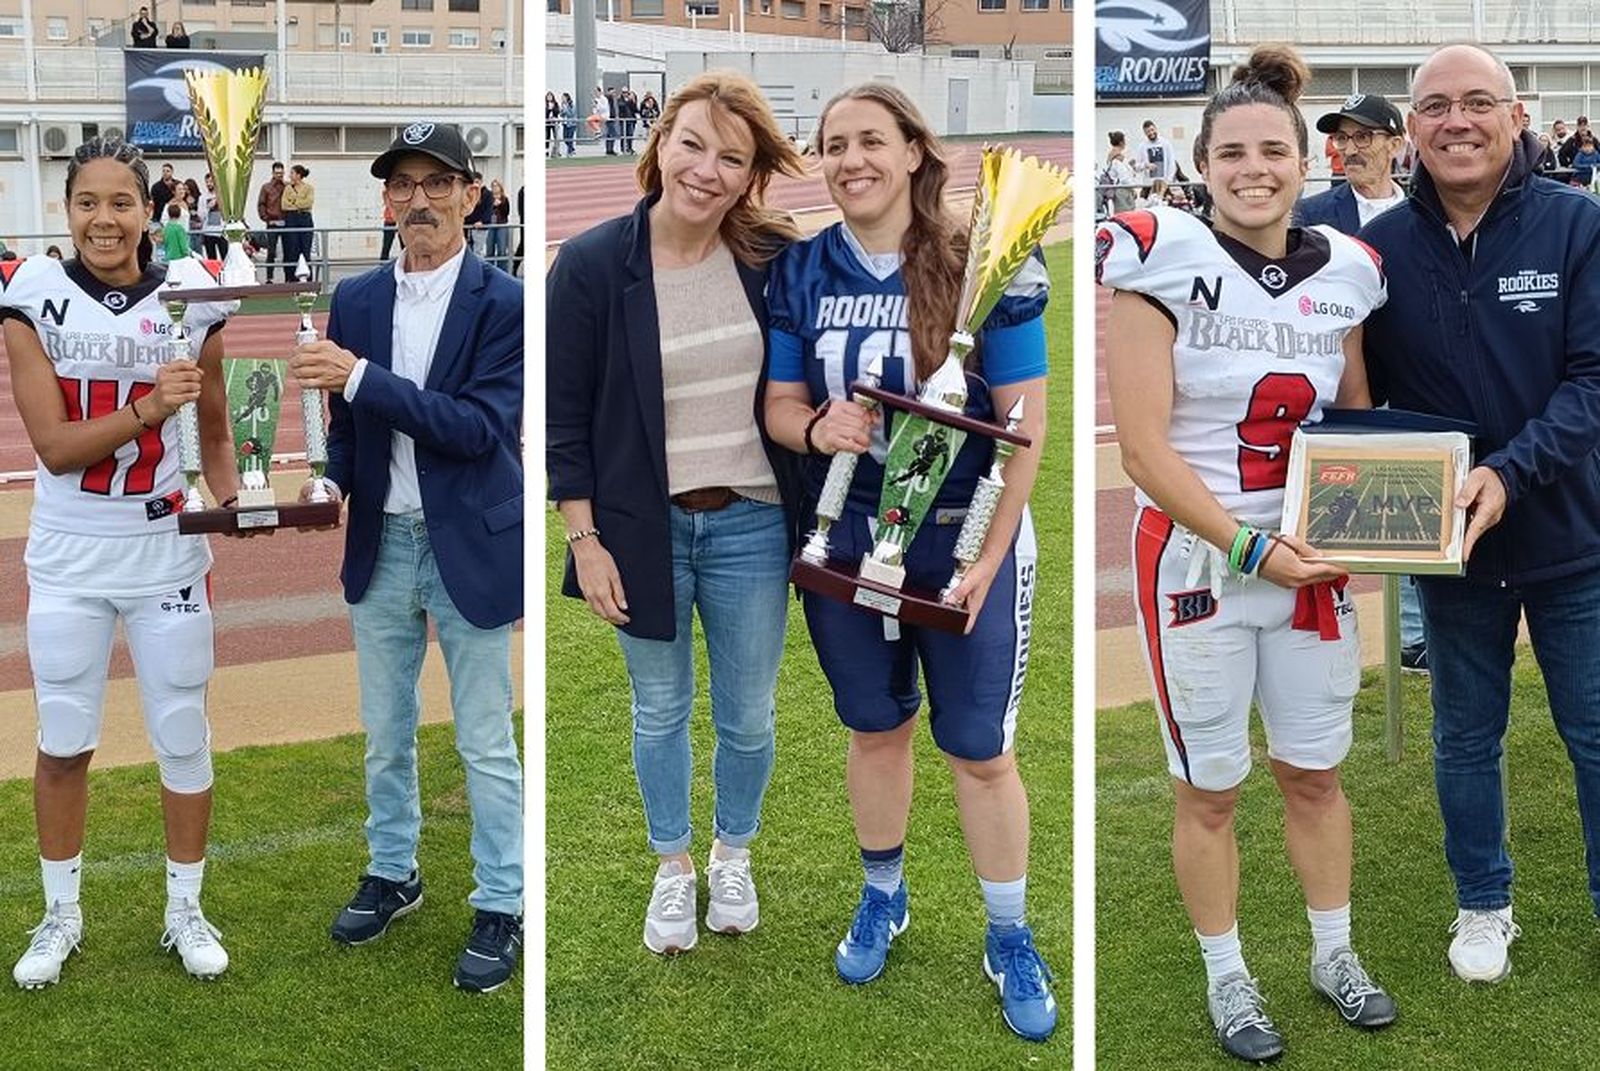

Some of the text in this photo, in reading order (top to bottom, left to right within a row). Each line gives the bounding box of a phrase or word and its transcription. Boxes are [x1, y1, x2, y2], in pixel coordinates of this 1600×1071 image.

[1119, 57, 1209, 83] ROOKIES
[1498, 274, 1559, 293] ROOKIES
[1313, 301, 1355, 319] LG OLED
[153, 323, 165, 334] LG
[1236, 371, 1317, 492] 9
[1371, 495, 1435, 513] MVP
[161, 602, 200, 613] G-TEC
